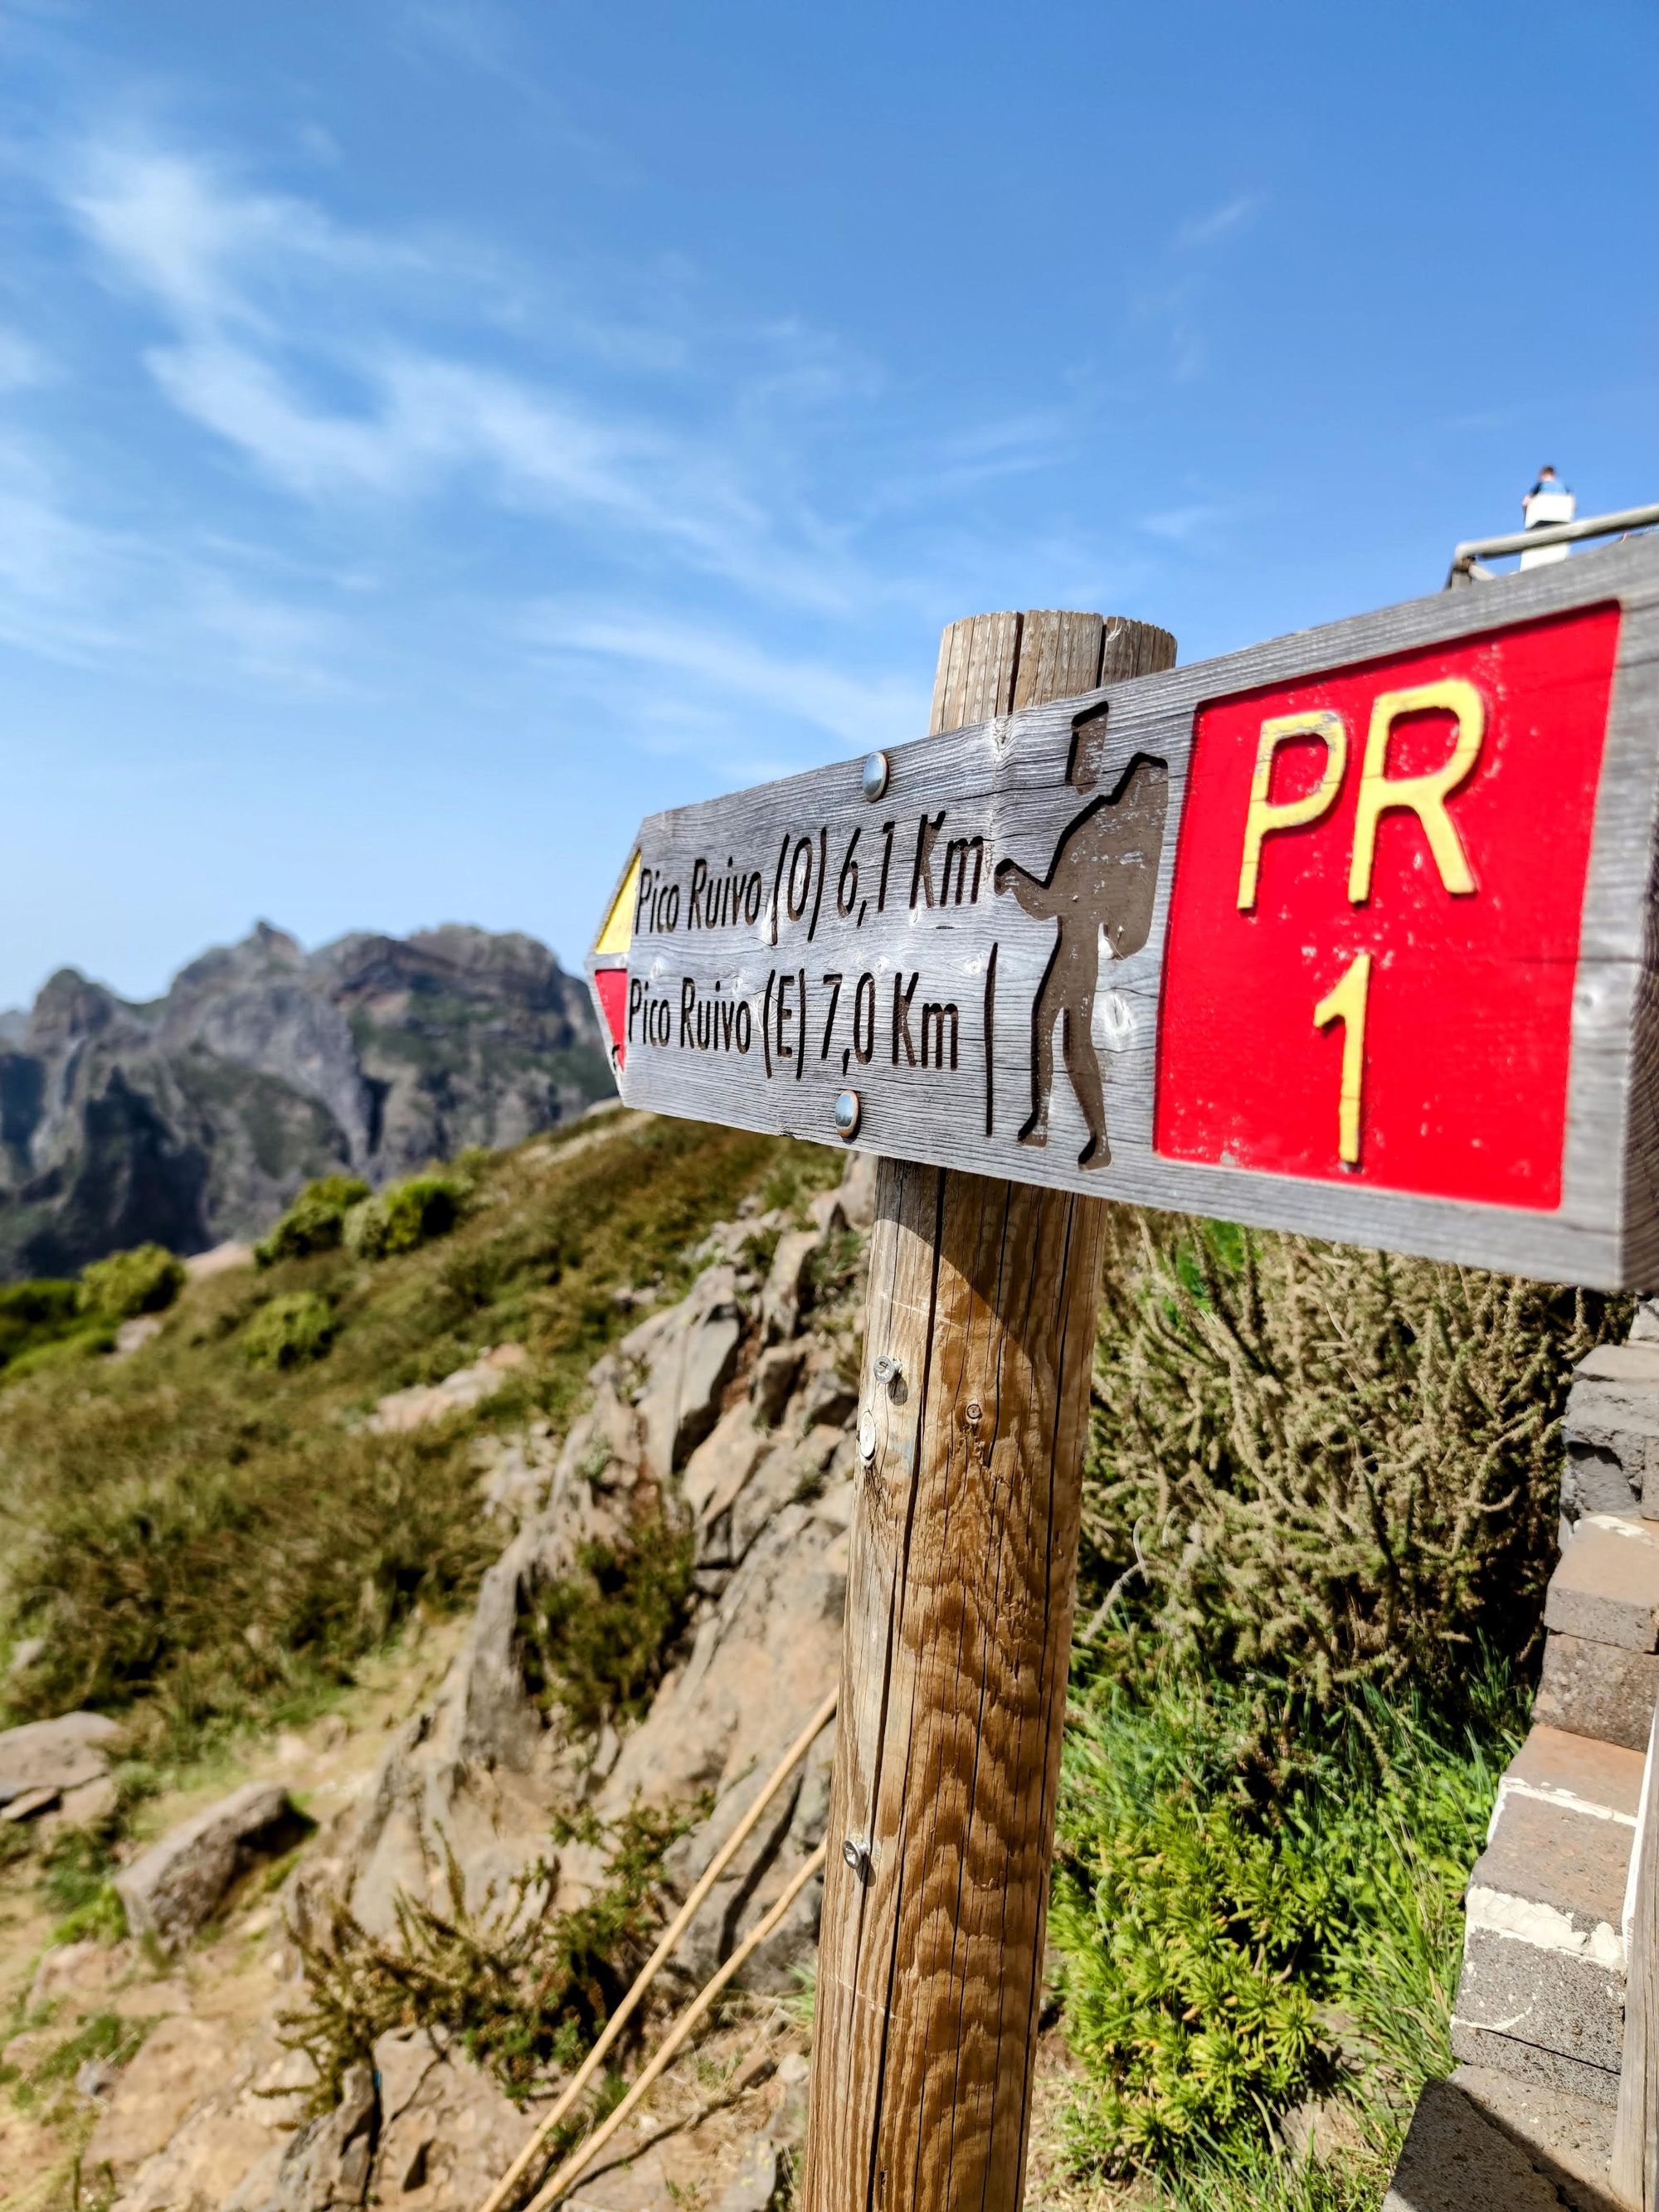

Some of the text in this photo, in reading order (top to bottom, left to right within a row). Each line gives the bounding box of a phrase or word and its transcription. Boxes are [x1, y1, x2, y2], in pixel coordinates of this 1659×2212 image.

[635, 868, 679, 935] Pico
[688, 856, 762, 931] Ruivo
[837, 820, 896, 928] 6,1
[909, 810, 985, 910] Km
[1237, 678, 1484, 910] PR
[628, 968, 960, 1080] Pico Ruivo (E) 7,0 Km
[1314, 954, 1370, 1164] 1
